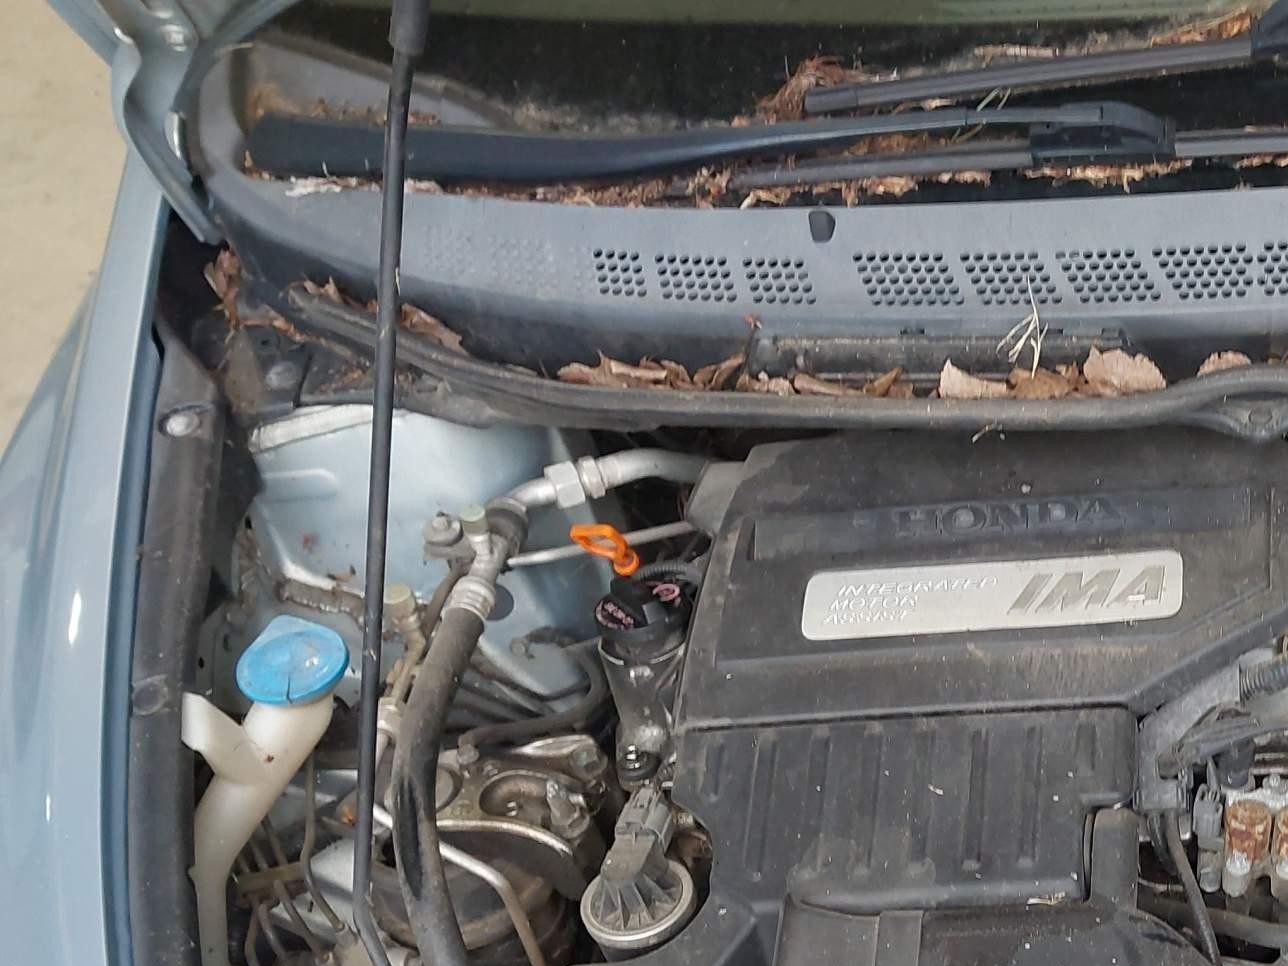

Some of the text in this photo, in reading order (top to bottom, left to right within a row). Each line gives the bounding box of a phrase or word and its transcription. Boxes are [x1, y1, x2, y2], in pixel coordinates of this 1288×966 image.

[892, 500, 1128, 537] HONDA
[829, 594, 919, 611] MOTOR
[1005, 564, 1168, 615] IMA
